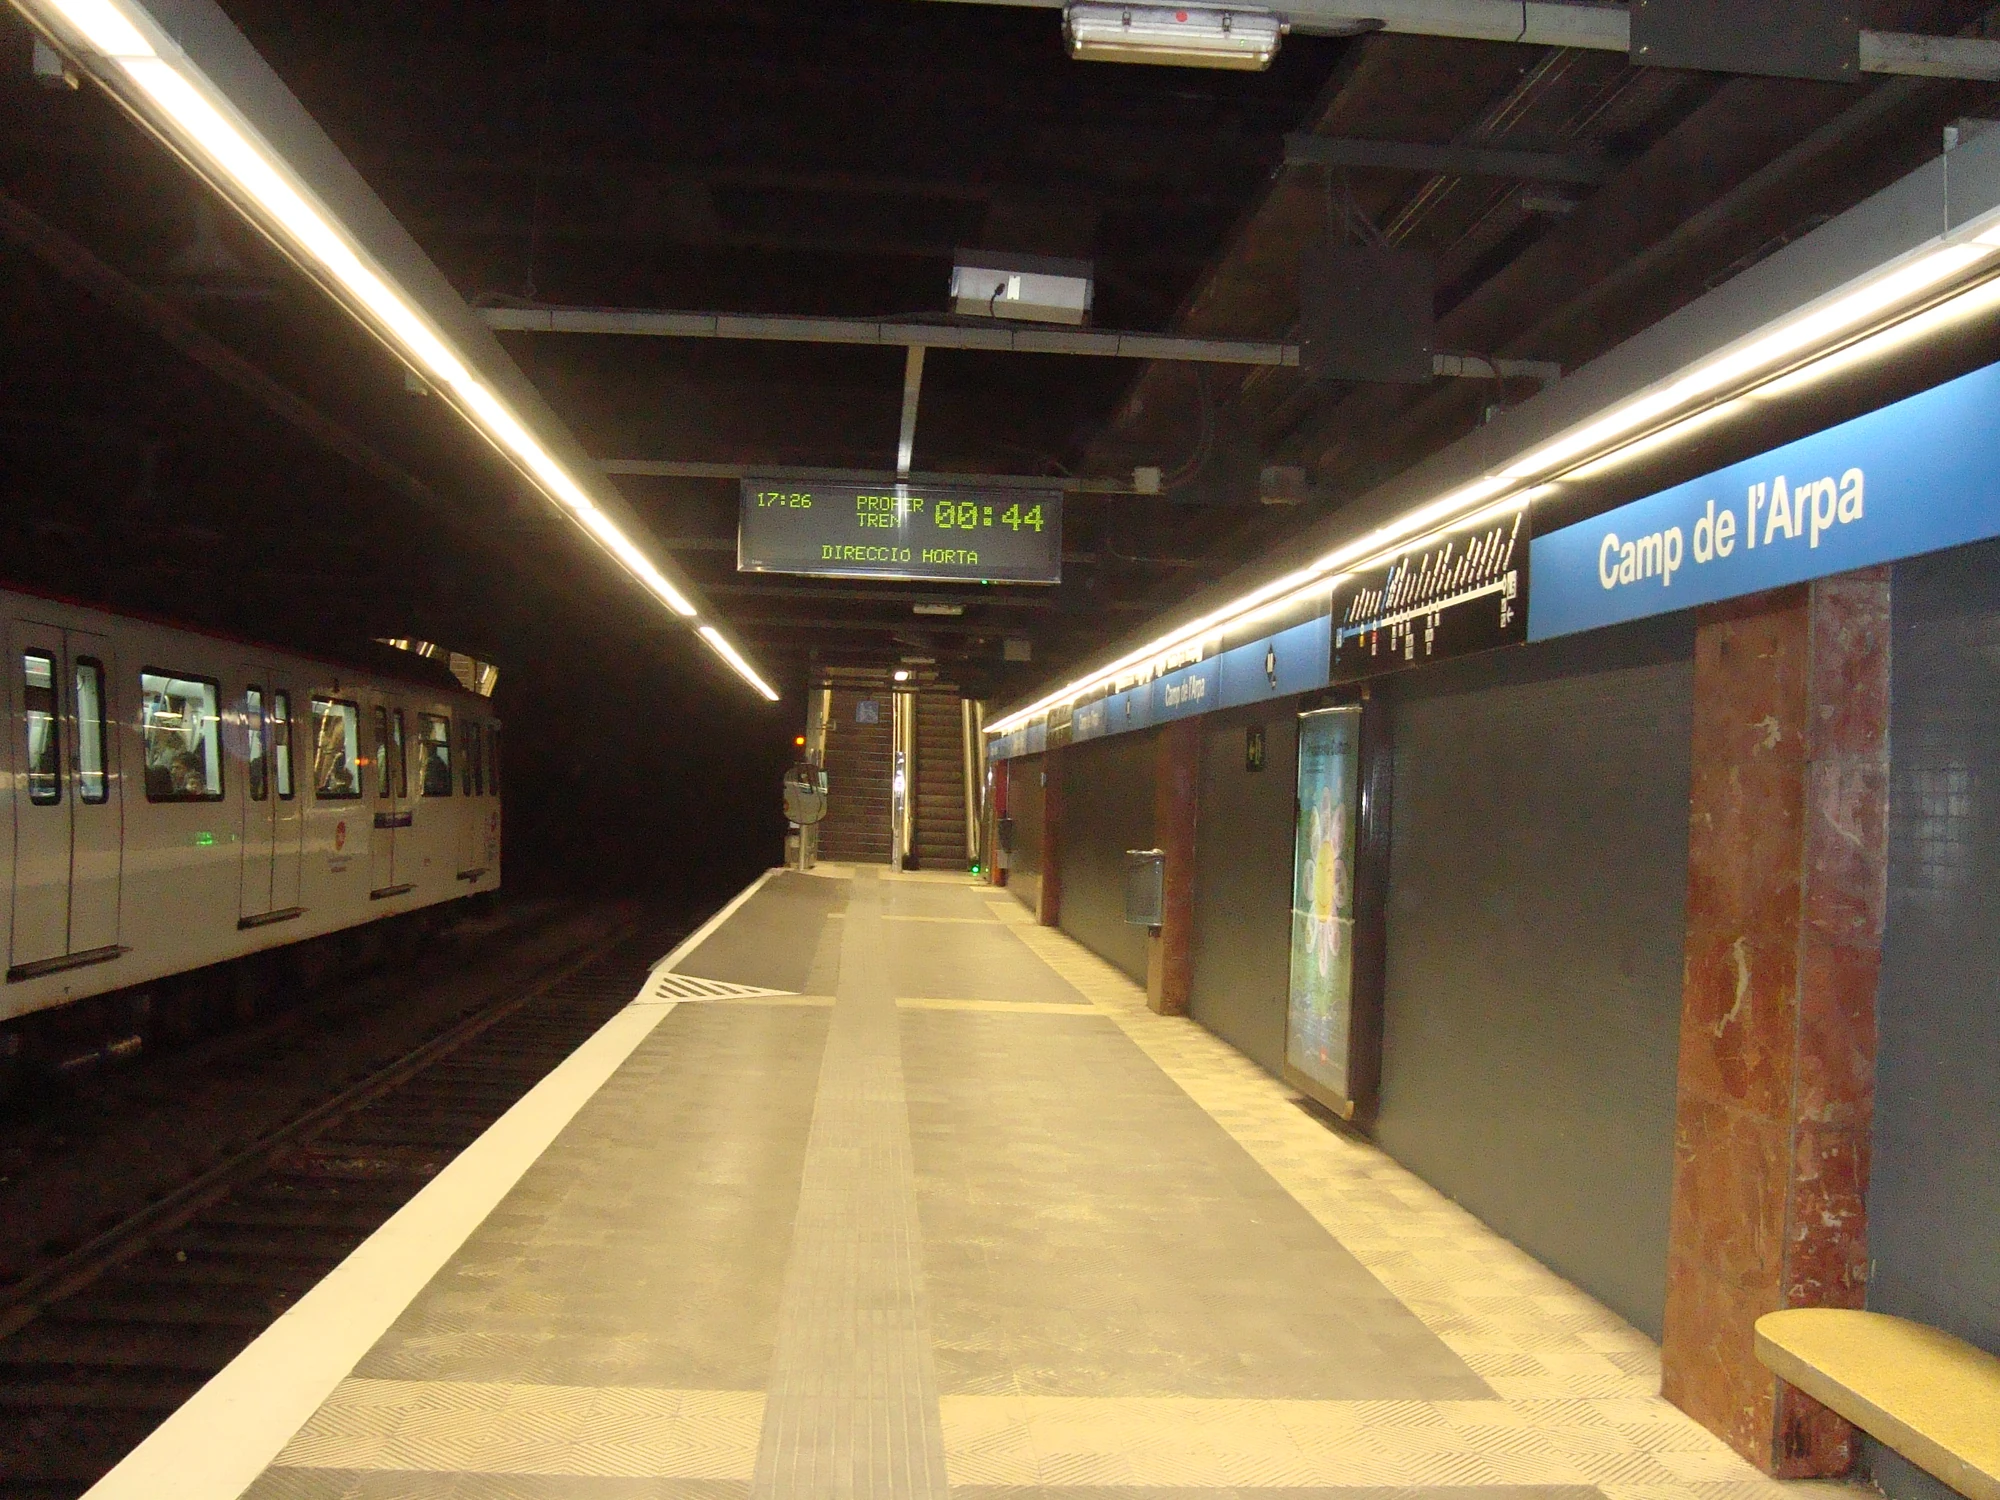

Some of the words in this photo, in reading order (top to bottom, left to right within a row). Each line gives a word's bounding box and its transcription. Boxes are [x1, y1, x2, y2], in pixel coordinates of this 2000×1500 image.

[758, 493, 812, 508] 17:26
[857, 496, 924, 513] PROPER
[857, 513, 902, 528] TREN
[935, 501, 1044, 532] 00:44
[1599, 525, 1683, 590] Camp
[1694, 500, 1736, 564] de
[1747, 467, 1864, 549] l'Arpa
[922, 548, 978, 565] HORTA
[1165, 683, 1180, 709] Camp
